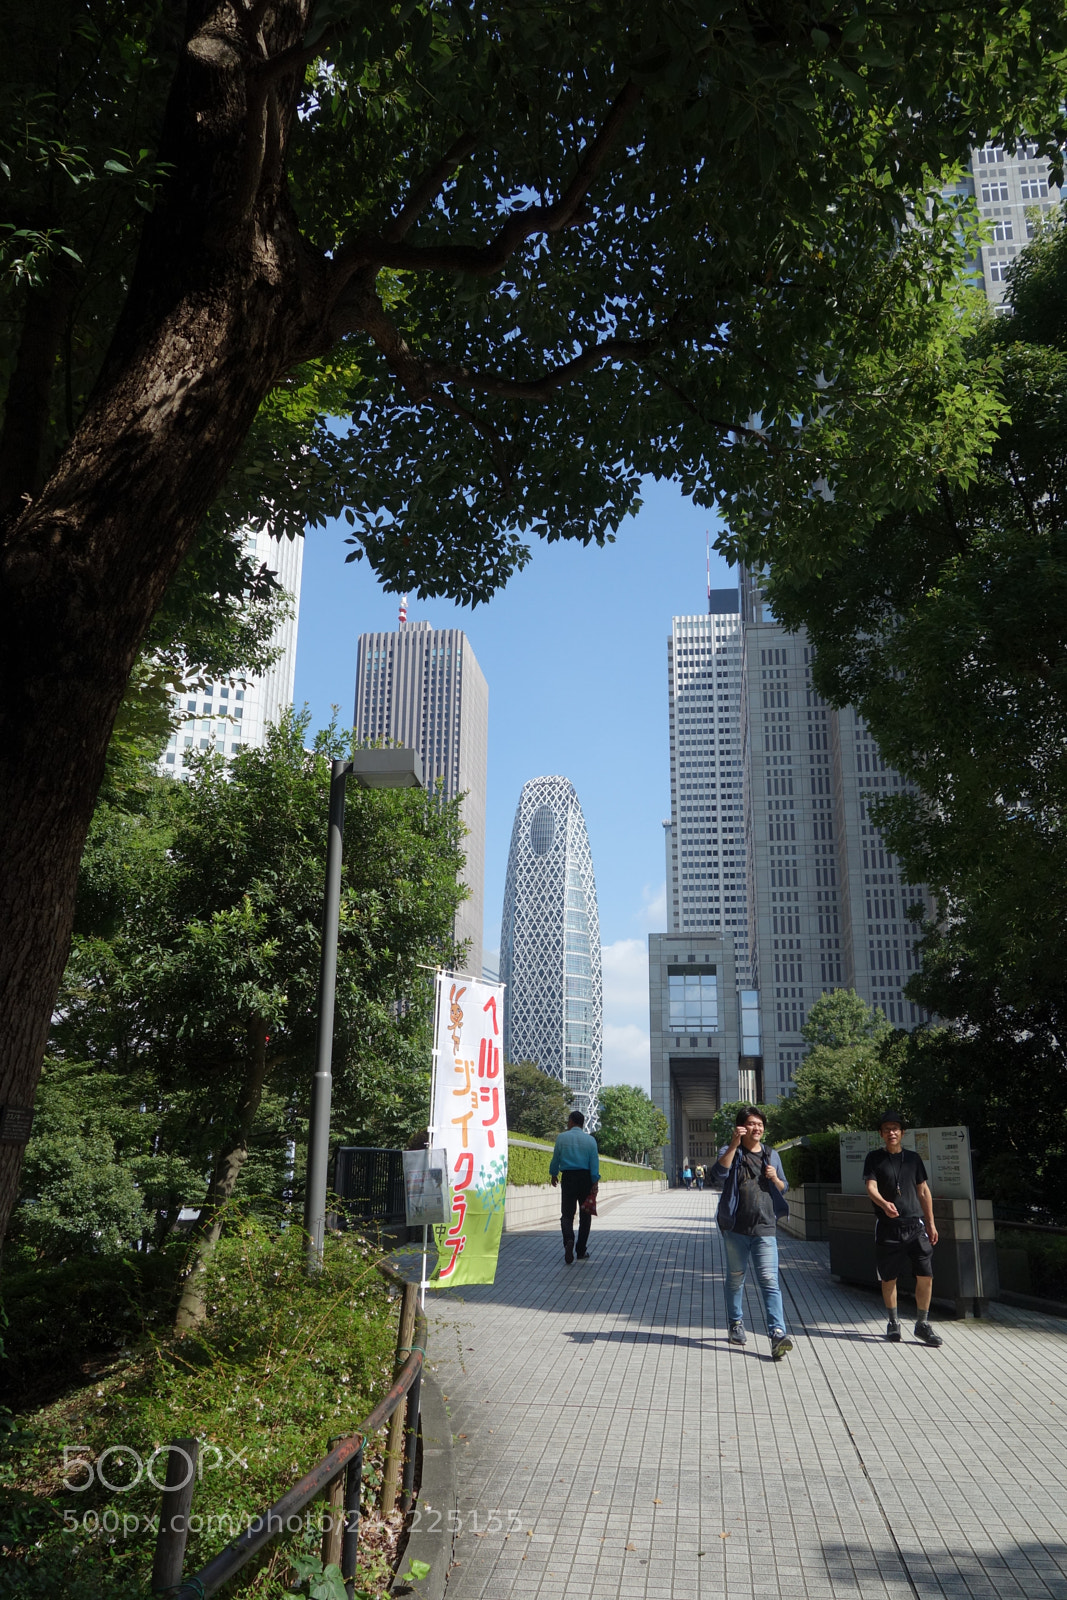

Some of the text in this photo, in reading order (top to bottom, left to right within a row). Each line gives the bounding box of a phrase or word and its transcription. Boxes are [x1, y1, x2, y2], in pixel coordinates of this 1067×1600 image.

[478, 996, 499, 1148] ヘルシー
[439, 1059, 478, 1279] ジョイクラブ
